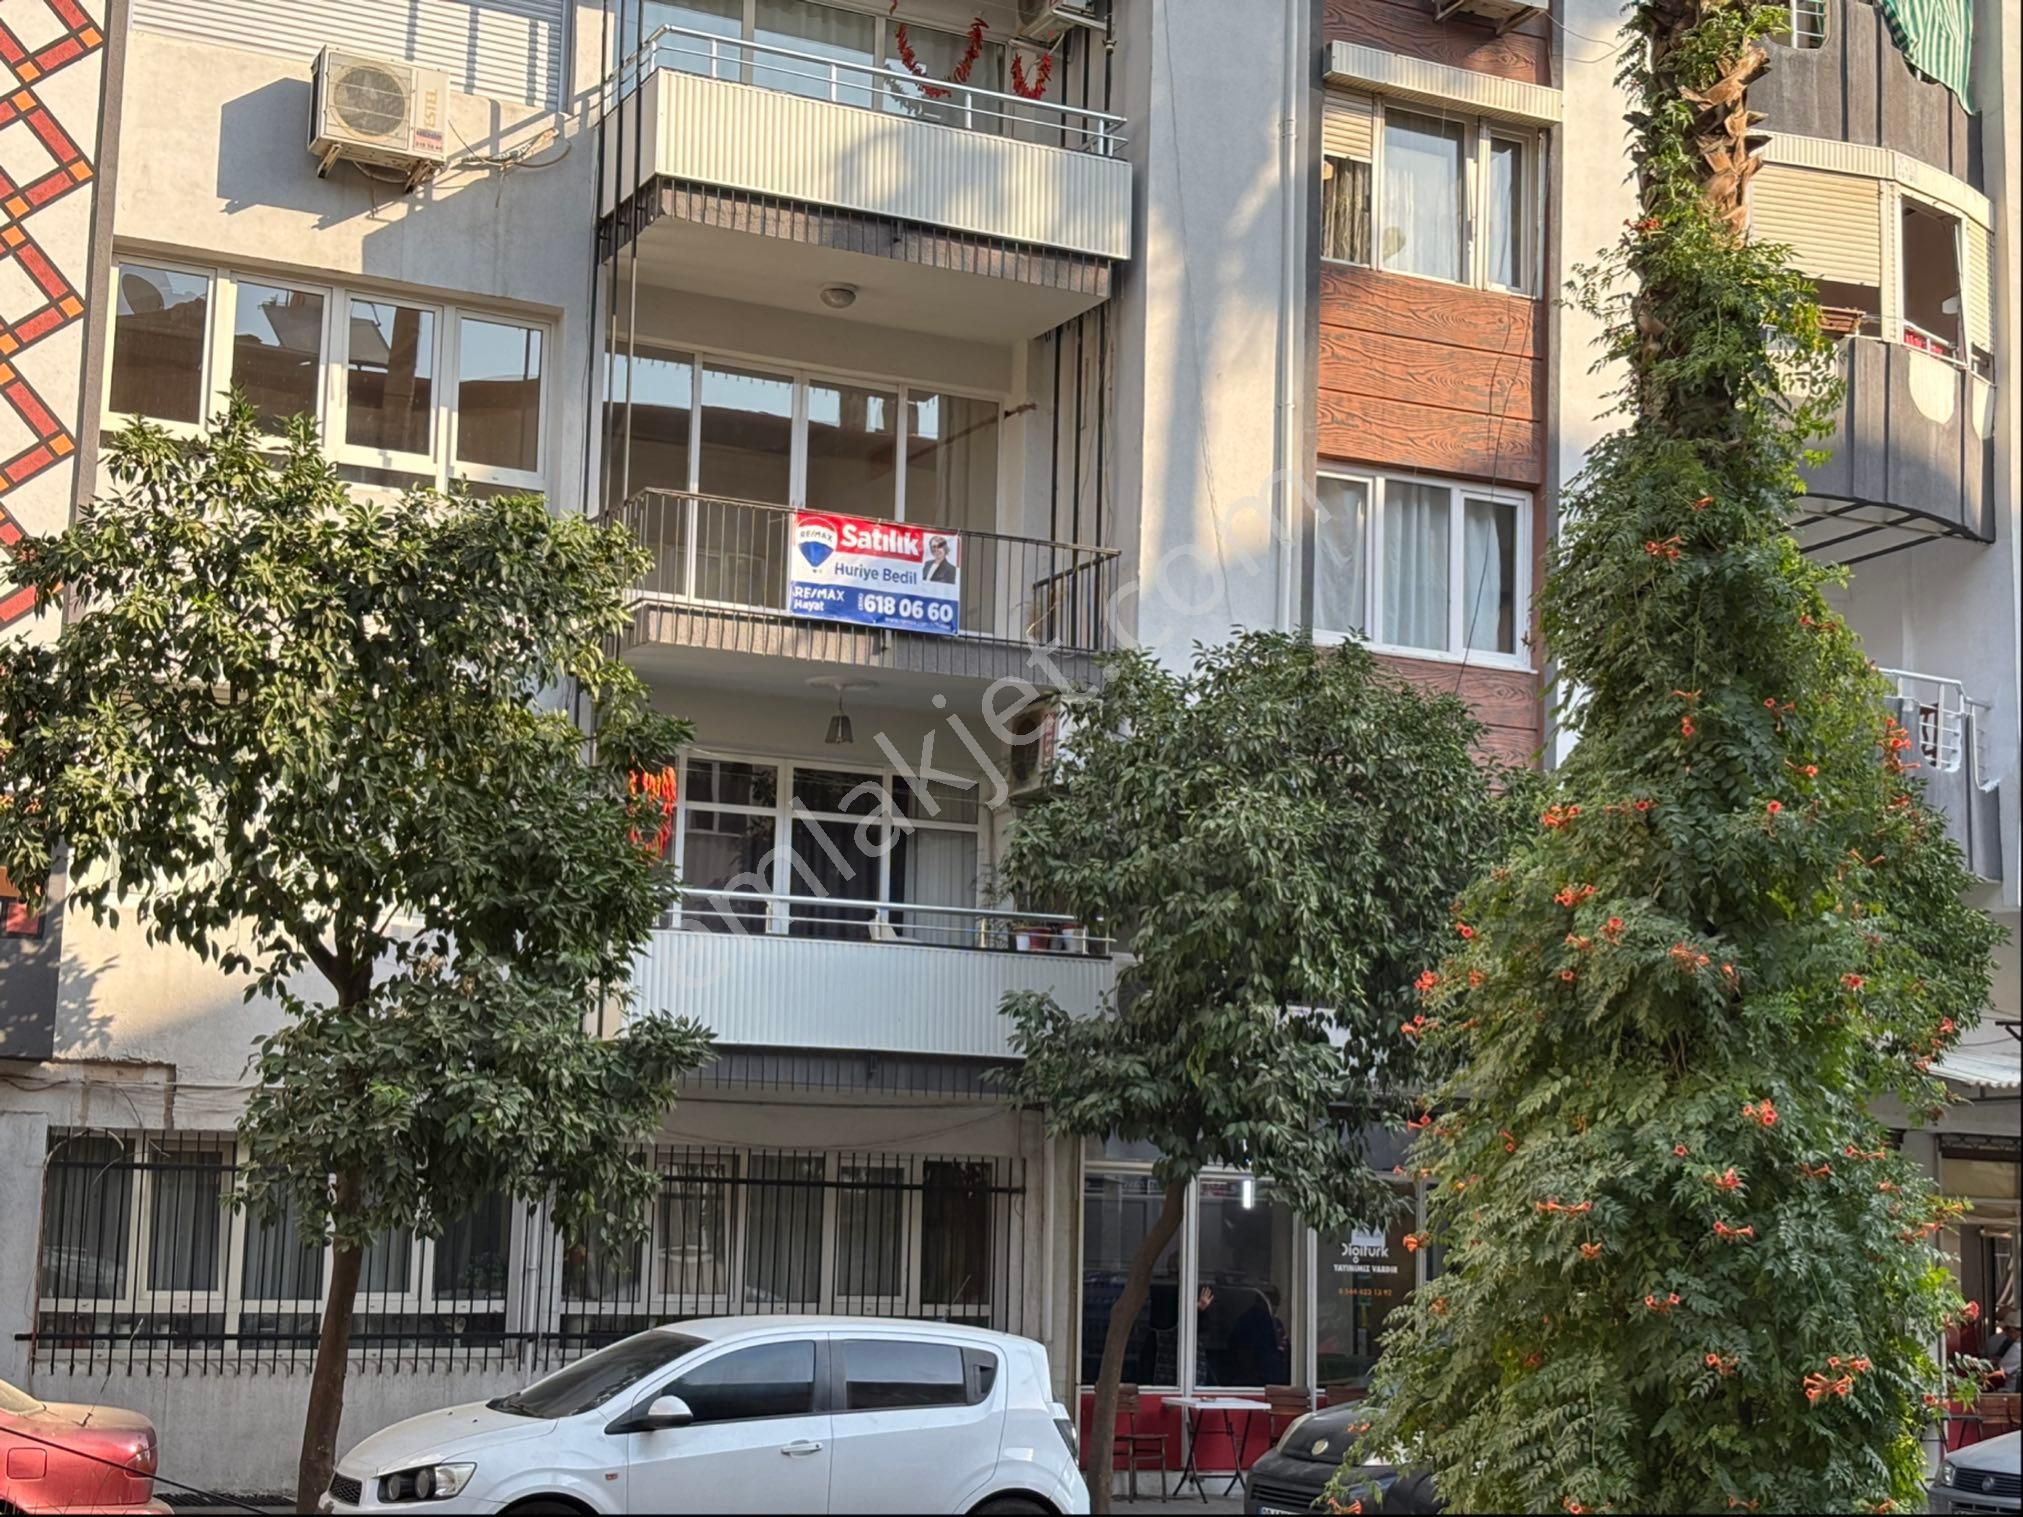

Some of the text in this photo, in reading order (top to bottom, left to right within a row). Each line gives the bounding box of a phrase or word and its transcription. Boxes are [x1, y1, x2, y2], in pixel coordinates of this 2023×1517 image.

[840, 523, 920, 557] Satılık
[834, 562, 917, 585] Huriye Bedil
[792, 586, 845, 602] RE/MAX
[793, 598, 825, 613] Hayat
[864, 593, 896, 616] 618
[899, 597, 924, 620] 06
[927, 601, 954, 623] 60
